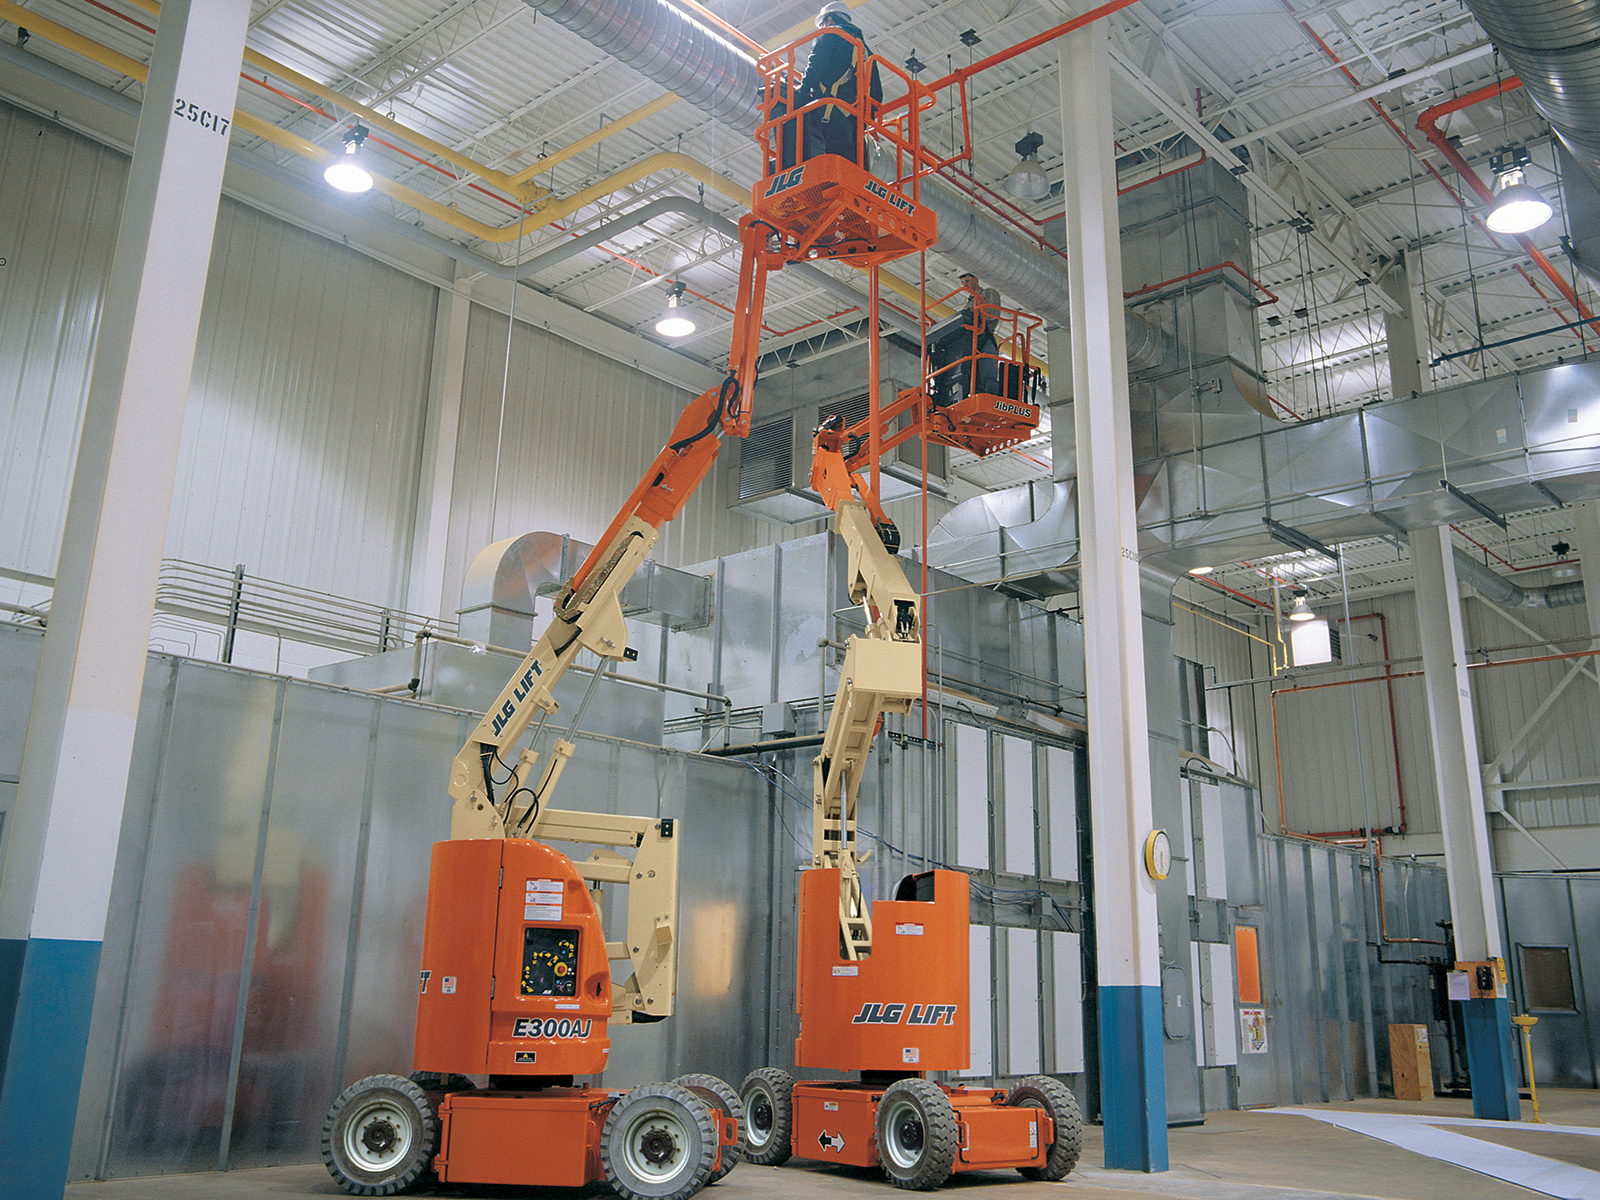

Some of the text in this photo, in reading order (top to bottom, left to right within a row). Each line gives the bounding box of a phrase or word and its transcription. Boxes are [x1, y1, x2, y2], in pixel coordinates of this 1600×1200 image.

[173, 98, 230, 136] 25C17
[764, 165, 806, 199] JLG
[864, 179, 916, 217] JLG LIFT
[994, 401, 1032, 418] JibPLUS
[491, 659, 543, 738] JLG LIFT
[512, 1018, 592, 1040] E300AJ
[851, 1002, 957, 1026] JLG LIFT
